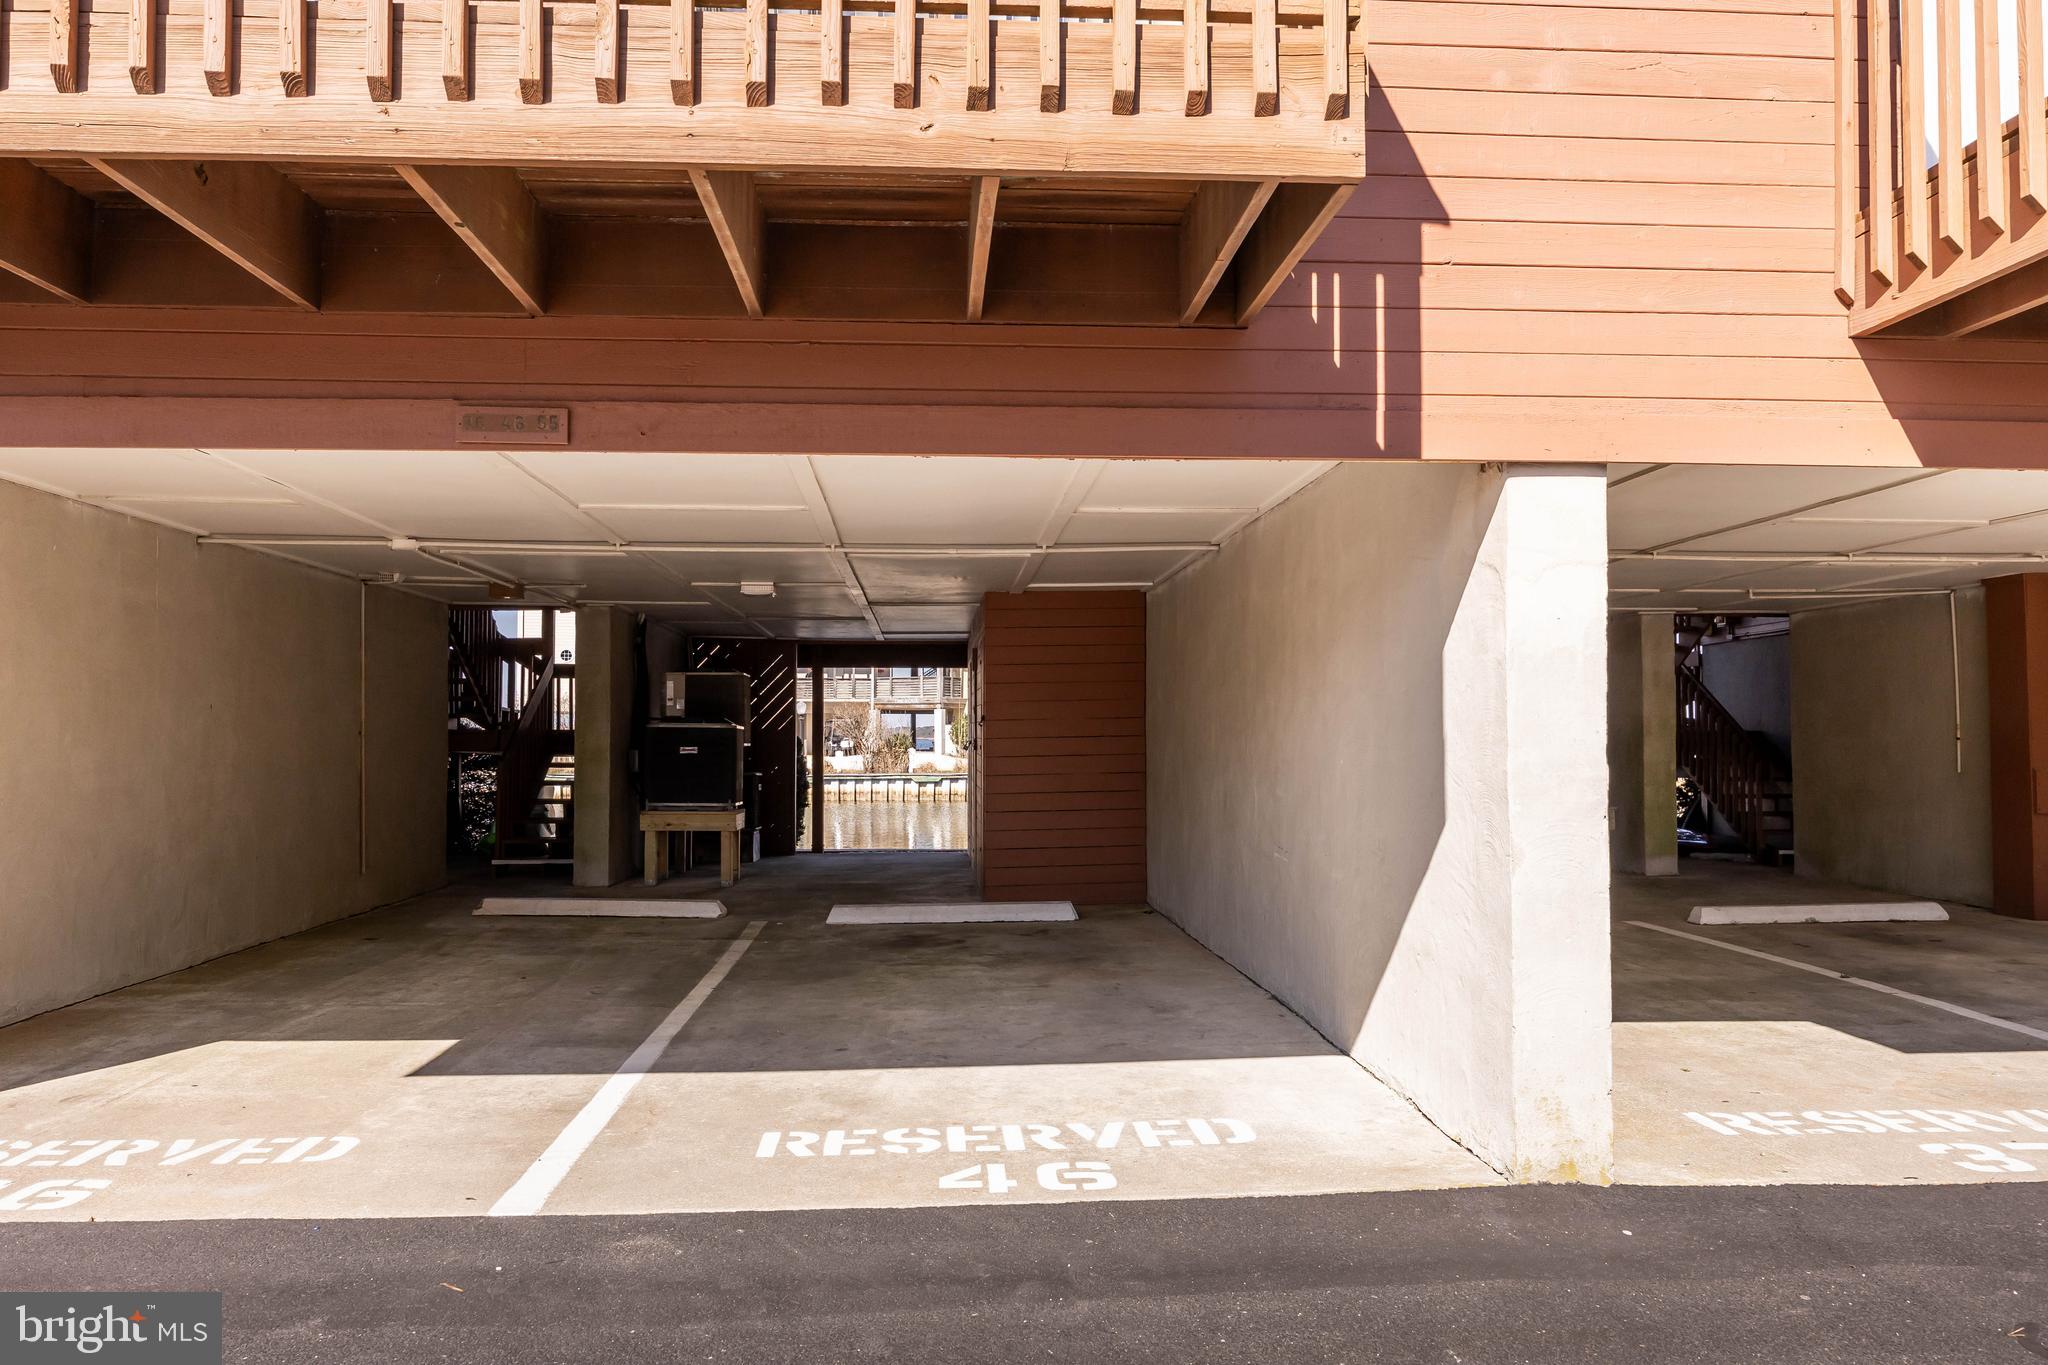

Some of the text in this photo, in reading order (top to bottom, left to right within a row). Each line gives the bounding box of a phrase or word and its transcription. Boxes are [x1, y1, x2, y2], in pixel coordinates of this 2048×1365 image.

[755, 1117, 1257, 1158] RESERVED
[938, 1161, 1118, 1194] 46
[0, 1178, 113, 1211] 6
